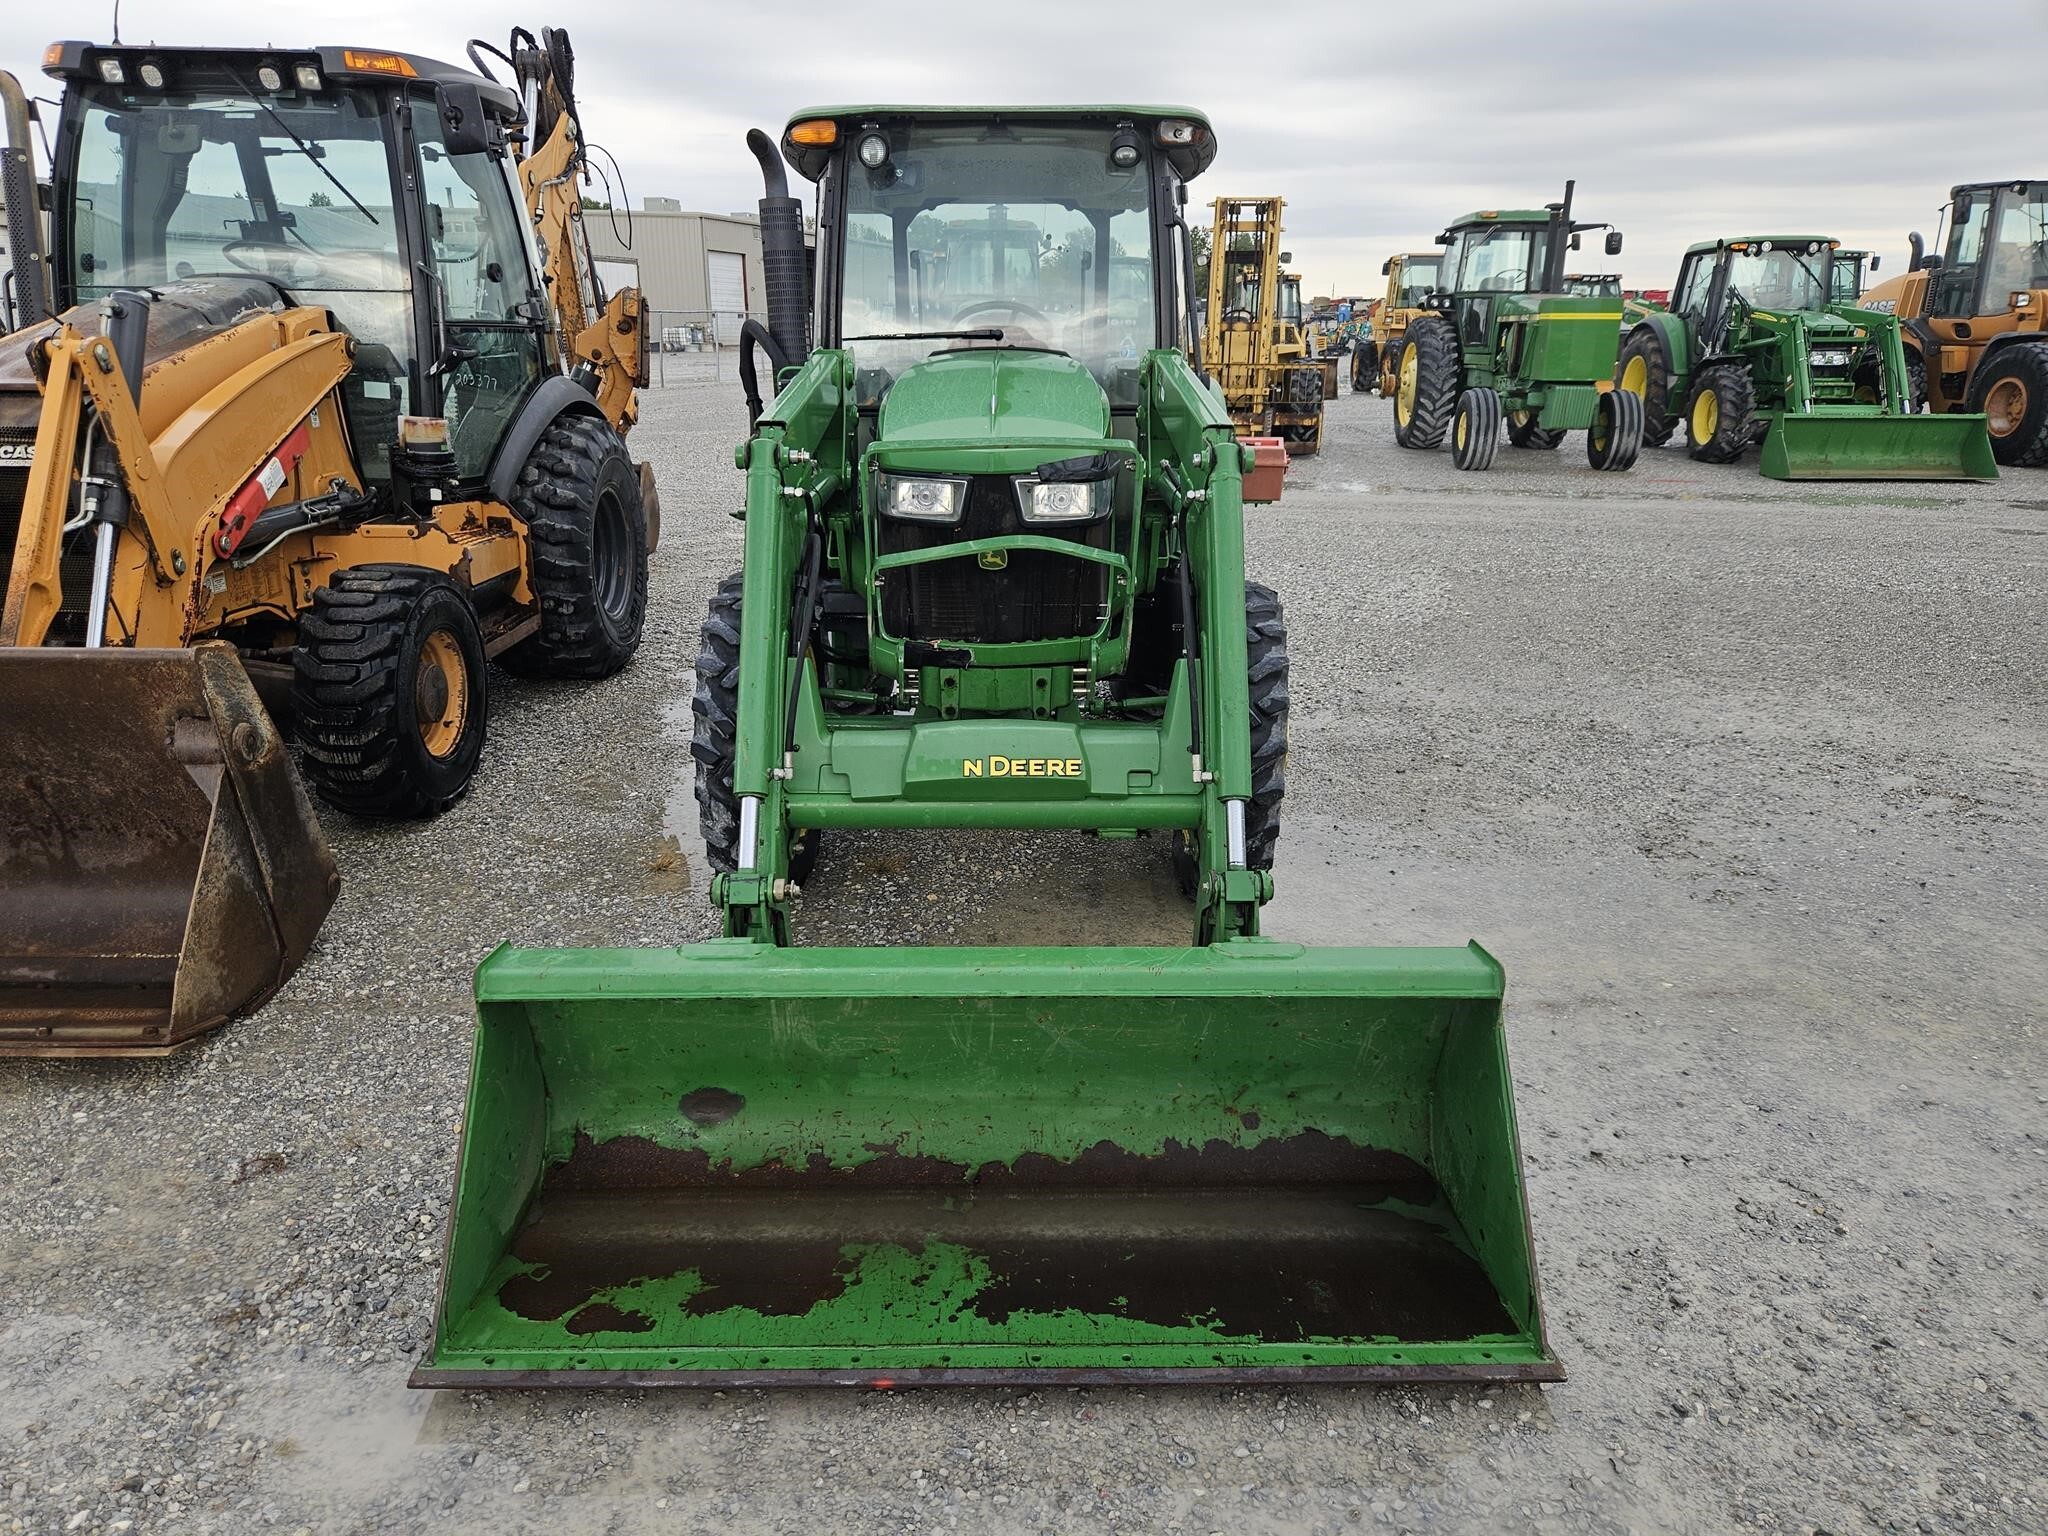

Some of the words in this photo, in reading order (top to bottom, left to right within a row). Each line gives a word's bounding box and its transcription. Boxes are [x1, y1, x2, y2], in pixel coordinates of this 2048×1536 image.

[455, 373, 497, 391] 203377
[0, 445, 35, 459] CAS
[989, 755, 1083, 777] DEERE
